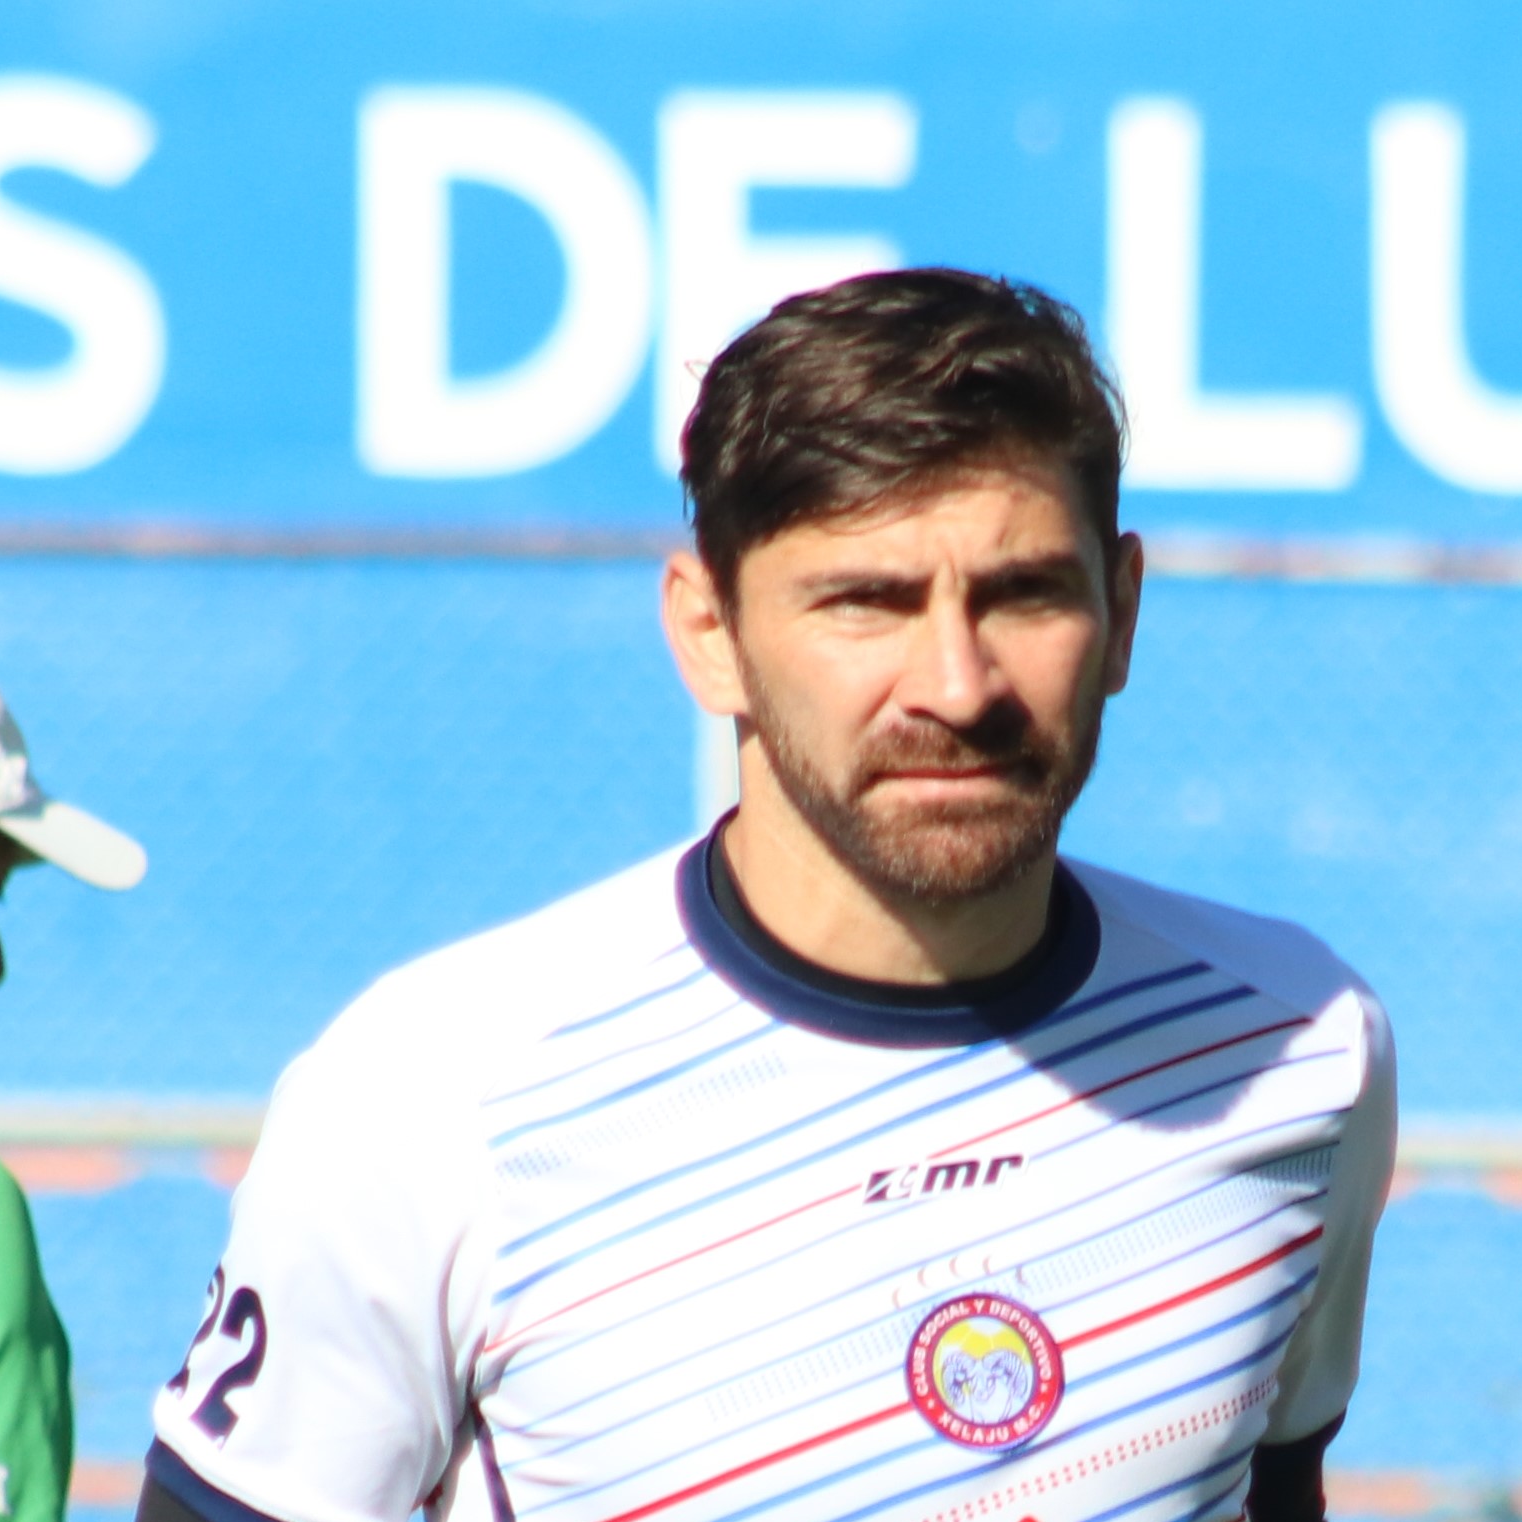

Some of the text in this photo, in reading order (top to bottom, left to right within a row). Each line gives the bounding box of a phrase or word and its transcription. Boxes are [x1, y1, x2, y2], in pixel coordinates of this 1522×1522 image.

[911, 1298, 1053, 1397] CLUB SOCIAL Y DEPORTIVO
[937, 1411, 1010, 1444] XELAJU
